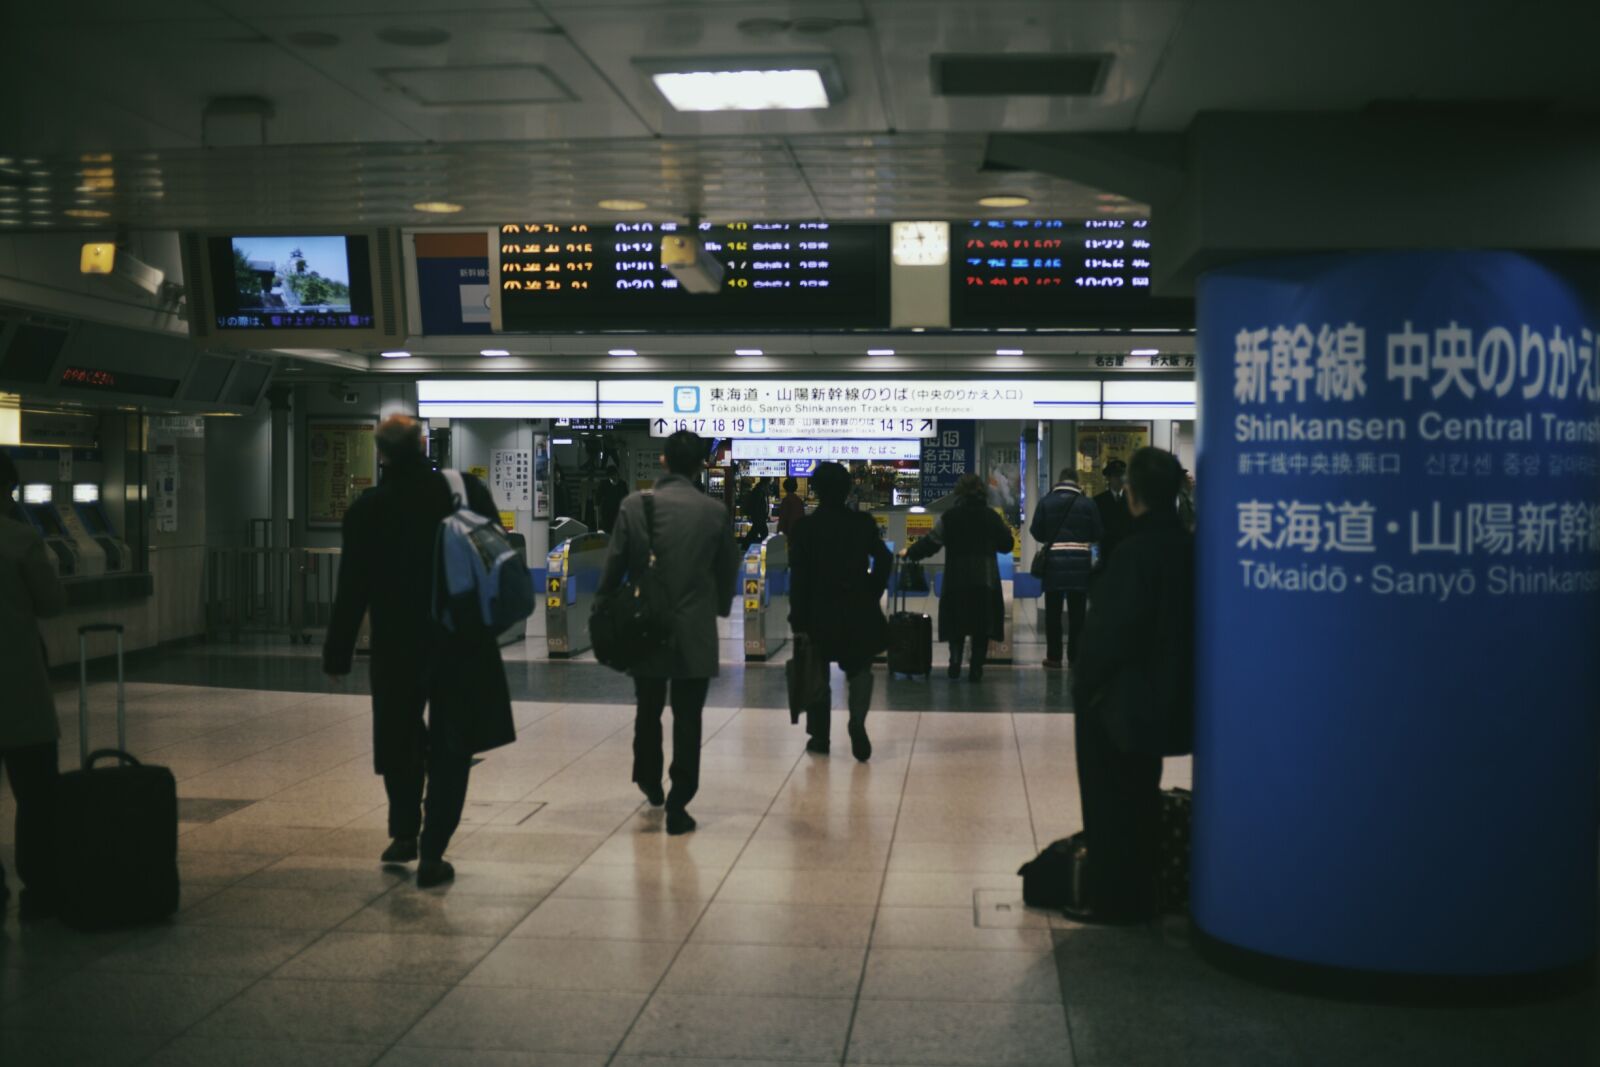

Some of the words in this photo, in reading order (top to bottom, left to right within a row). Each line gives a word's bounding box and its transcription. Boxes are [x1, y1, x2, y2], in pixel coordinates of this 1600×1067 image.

[1234, 322, 1367, 404] 新幹線
[1386, 320, 1600, 402] 中央のりかえ
[795, 404, 856, 413] Shinkansen
[861, 403, 897, 413] Tracks
[674, 419, 687, 432] 16
[693, 419, 706, 432] 17
[713, 419, 725, 432] 18
[732, 419, 745, 432] 19
[879, 419, 893, 432] 14
[899, 419, 914, 432] 15
[1235, 413, 1405, 442] Shinkansen
[1419, 411, 1532, 441] Central
[943, 433, 957, 445] 15
[777, 446, 823, 454] 東京みやげ
[868, 446, 897, 454] たばこ
[924, 449, 966, 461] 名古屋
[924, 463, 966, 475] 新大阪
